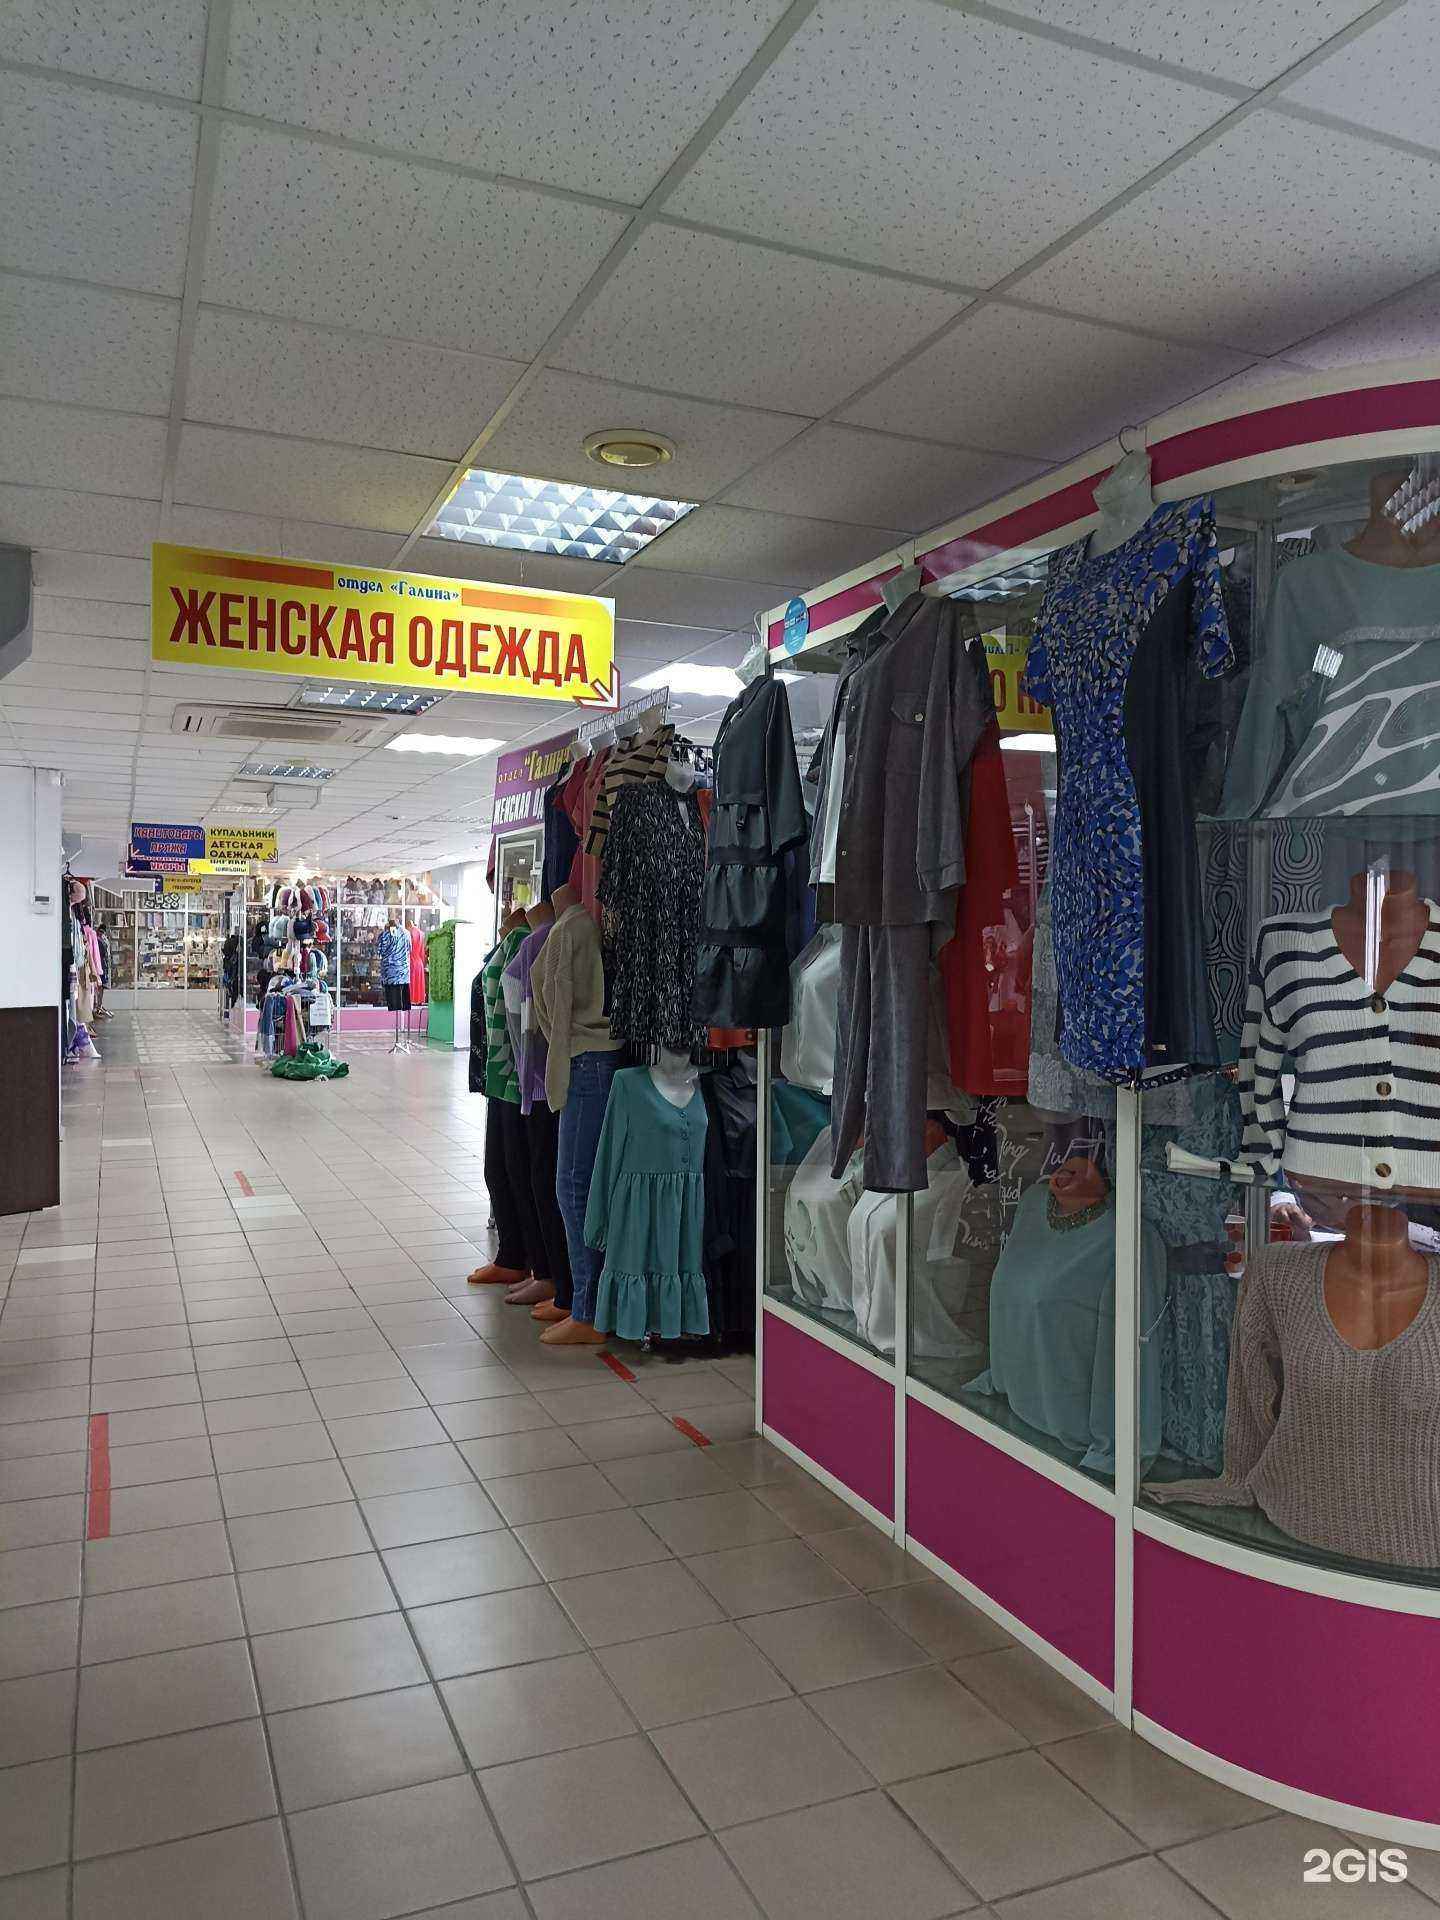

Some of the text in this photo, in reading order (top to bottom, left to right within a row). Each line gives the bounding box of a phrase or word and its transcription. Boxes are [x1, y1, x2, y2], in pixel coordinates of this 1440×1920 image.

[337, 576, 460, 602] отдел «Галина»
[169, 586, 589, 688] ЖЕНСКАЯ ОДЕЖДА
[493, 790, 532, 826] ЖЕНСКАЯ
[134, 827, 205, 841] КАНЦТОВАРЫ
[210, 828, 275, 839] КУПАЛЬНИКИ
[210, 840, 263, 850] ДЕТСКАЯ
[209, 850, 260, 860] ОДЕЖДА
